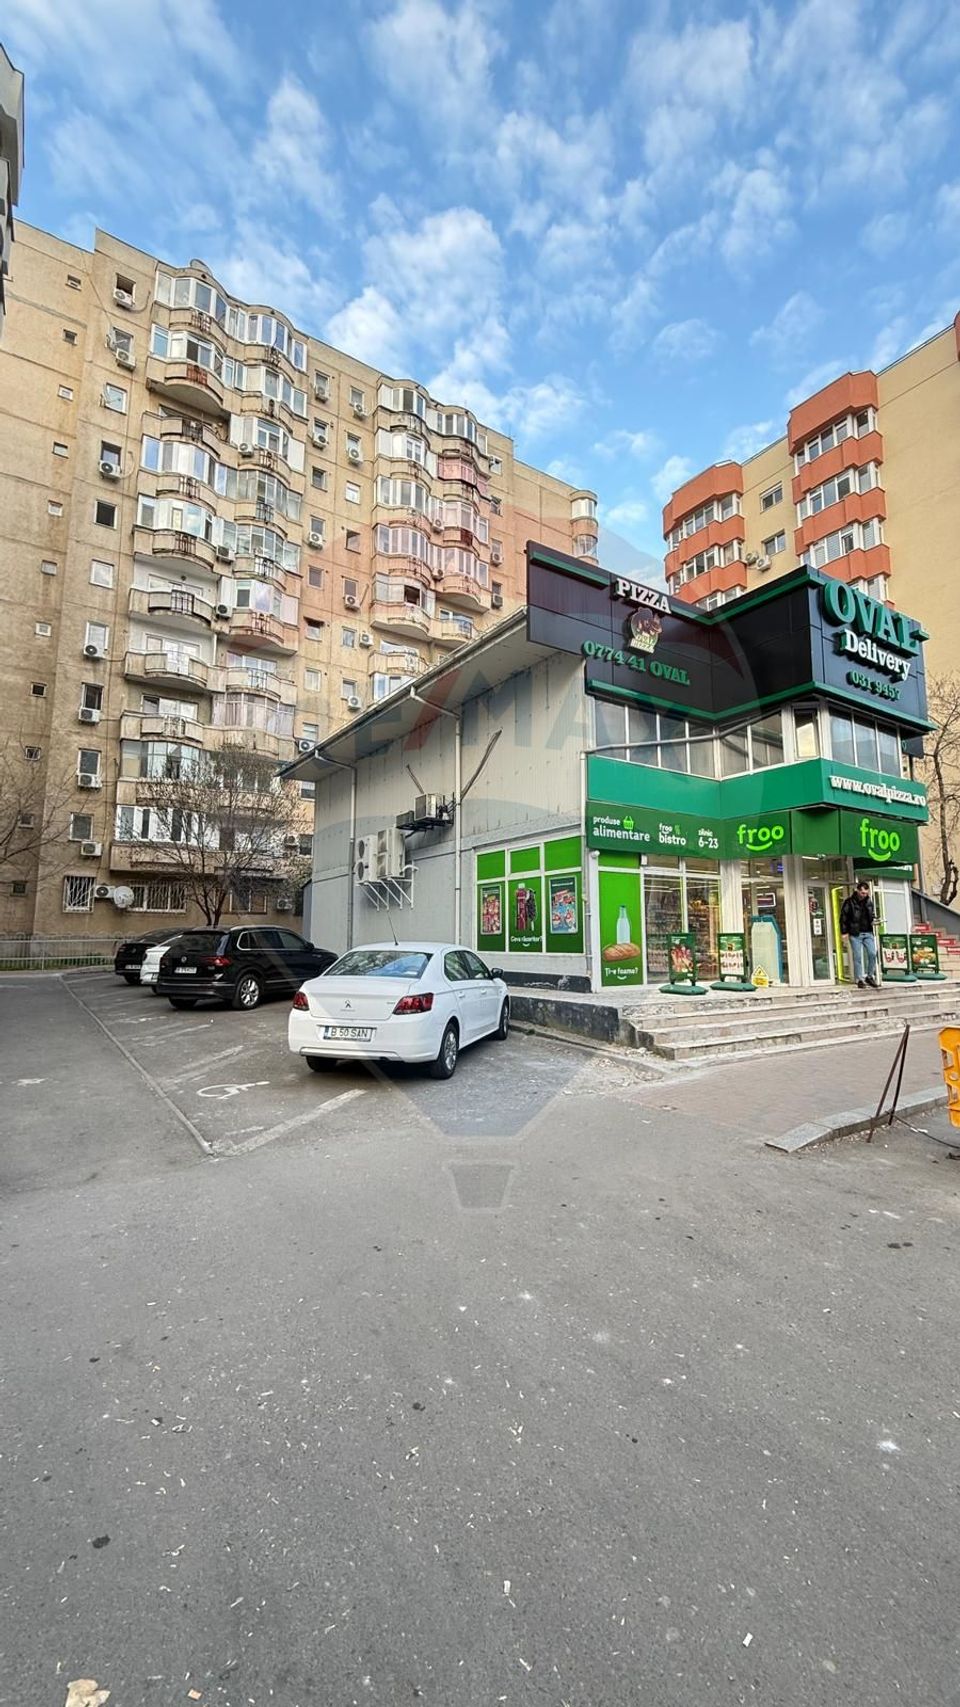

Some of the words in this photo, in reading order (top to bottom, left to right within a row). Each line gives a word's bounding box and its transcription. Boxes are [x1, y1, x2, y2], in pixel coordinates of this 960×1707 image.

[616, 578, 671, 614] PIZZA
[824, 580, 929, 656] OVAL
[583, 639, 625, 665] 0774
[628, 655, 646, 672] 41
[649, 660, 690, 685] OVAL
[843, 628, 910, 681] Delivery
[852, 670, 871, 690] 031
[829, 775, 926, 807] www.ovalpizza.ro
[593, 815, 620, 826] produse
[593, 825, 650, 842] alimentare
[659, 832, 687, 845] bistro
[698, 837, 719, 849] 6-23
[736, 824, 784, 844] froo
[860, 818, 900, 852] froo
[331, 1027, 338, 1036] B
[340, 1028, 349, 1037] 50
[350, 1028, 368, 1038] SAN
